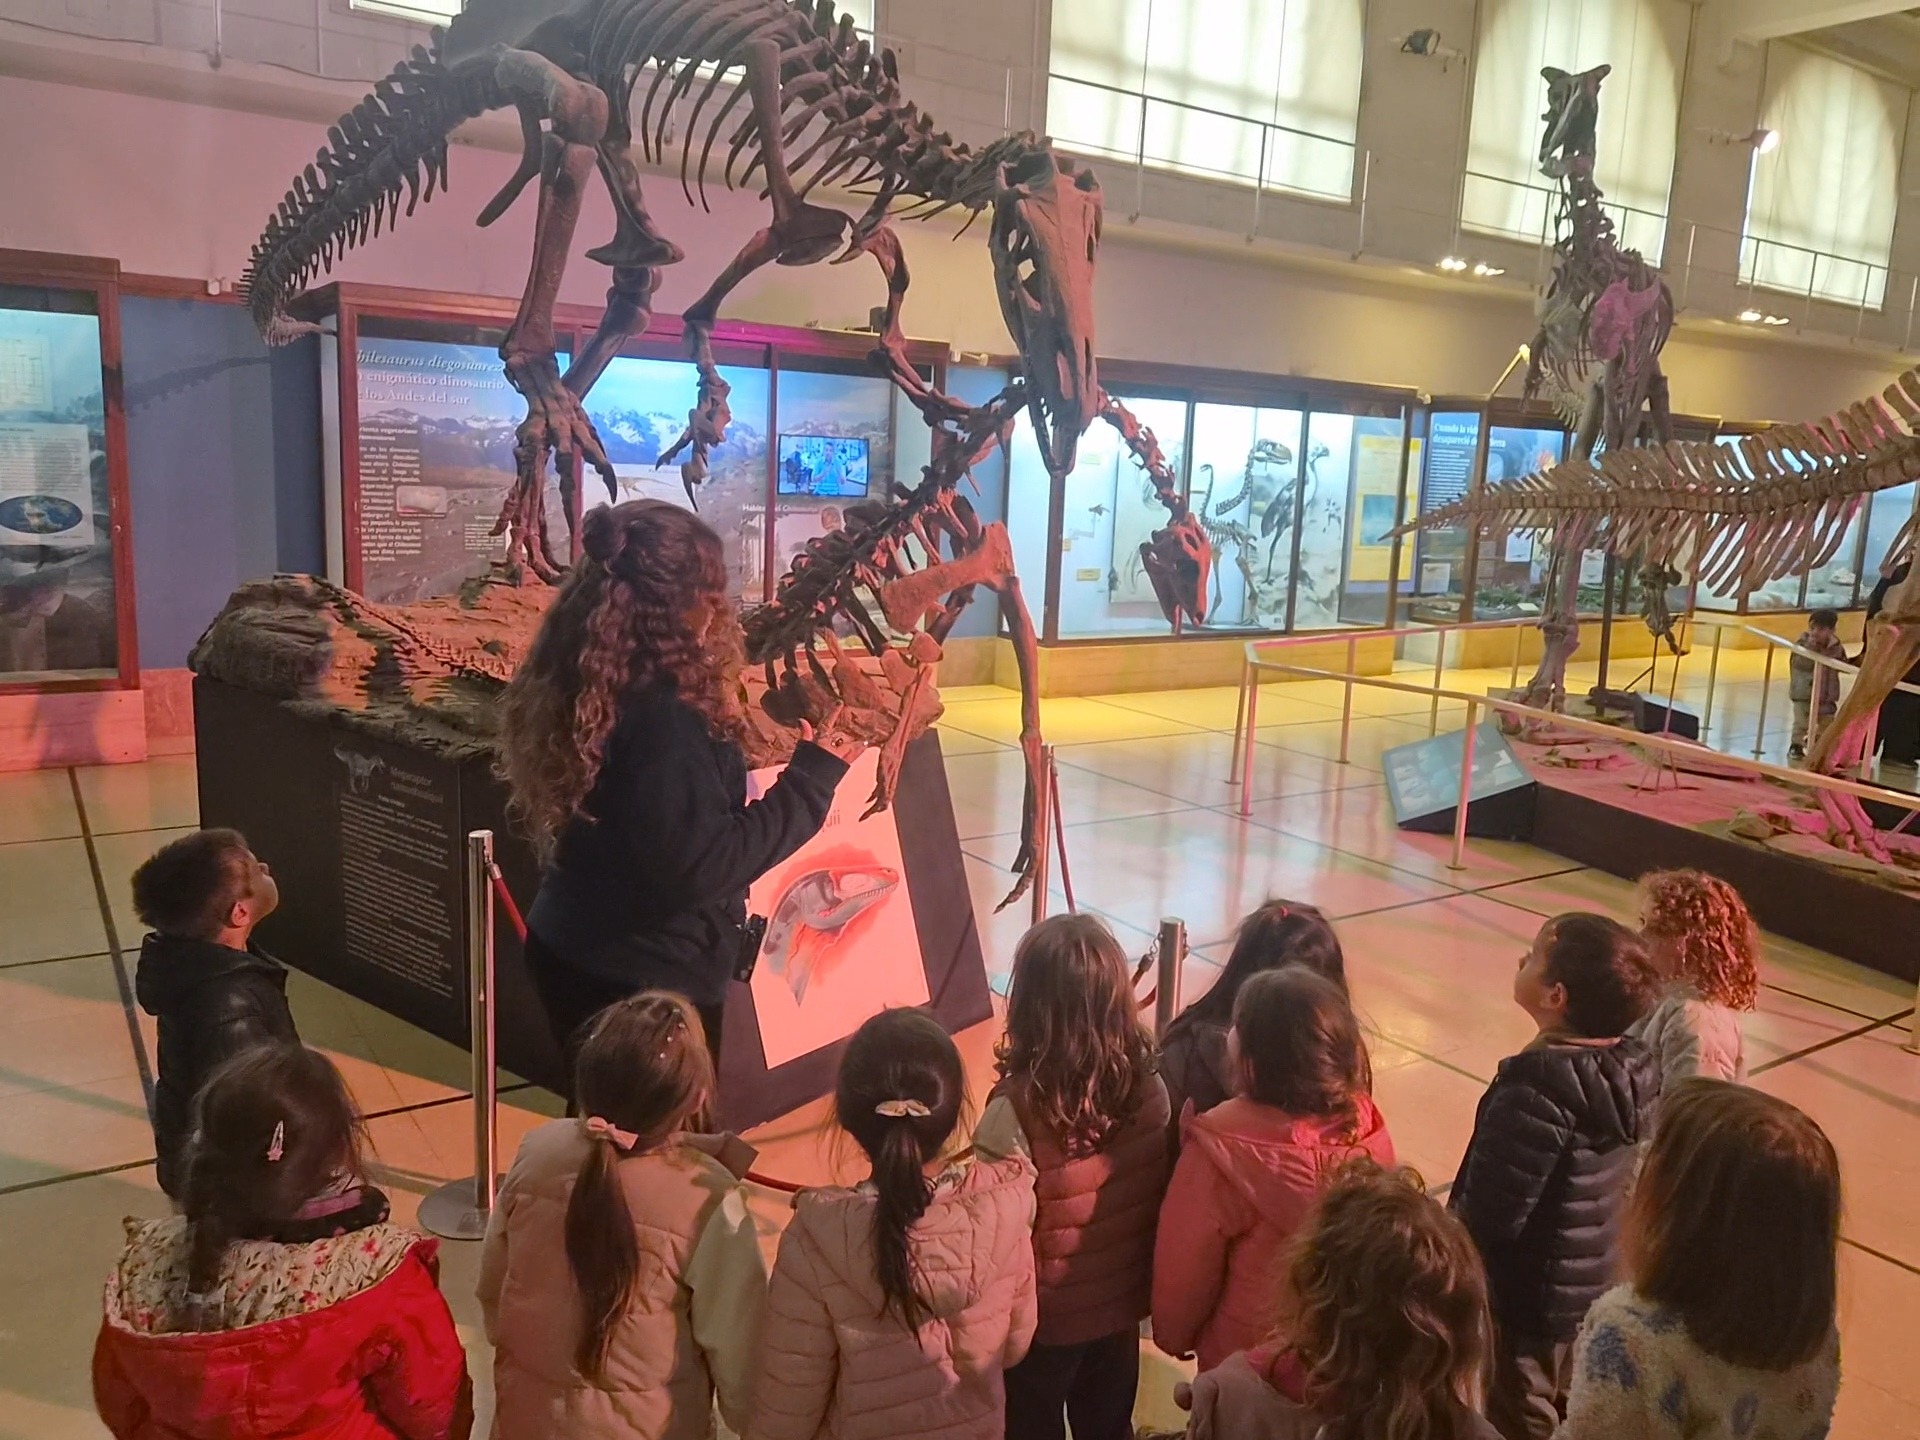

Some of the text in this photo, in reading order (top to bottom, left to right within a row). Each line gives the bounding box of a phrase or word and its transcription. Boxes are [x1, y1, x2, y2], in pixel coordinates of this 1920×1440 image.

[357, 349, 425, 366] hilesaurus
[367, 371, 437, 386] enigmático
[440, 374, 505, 389] dinosaurio
[387, 389, 425, 402] Andes
[428, 391, 448, 403] del
[452, 396, 470, 405] sur
[1466, 425, 1479, 435] vid
